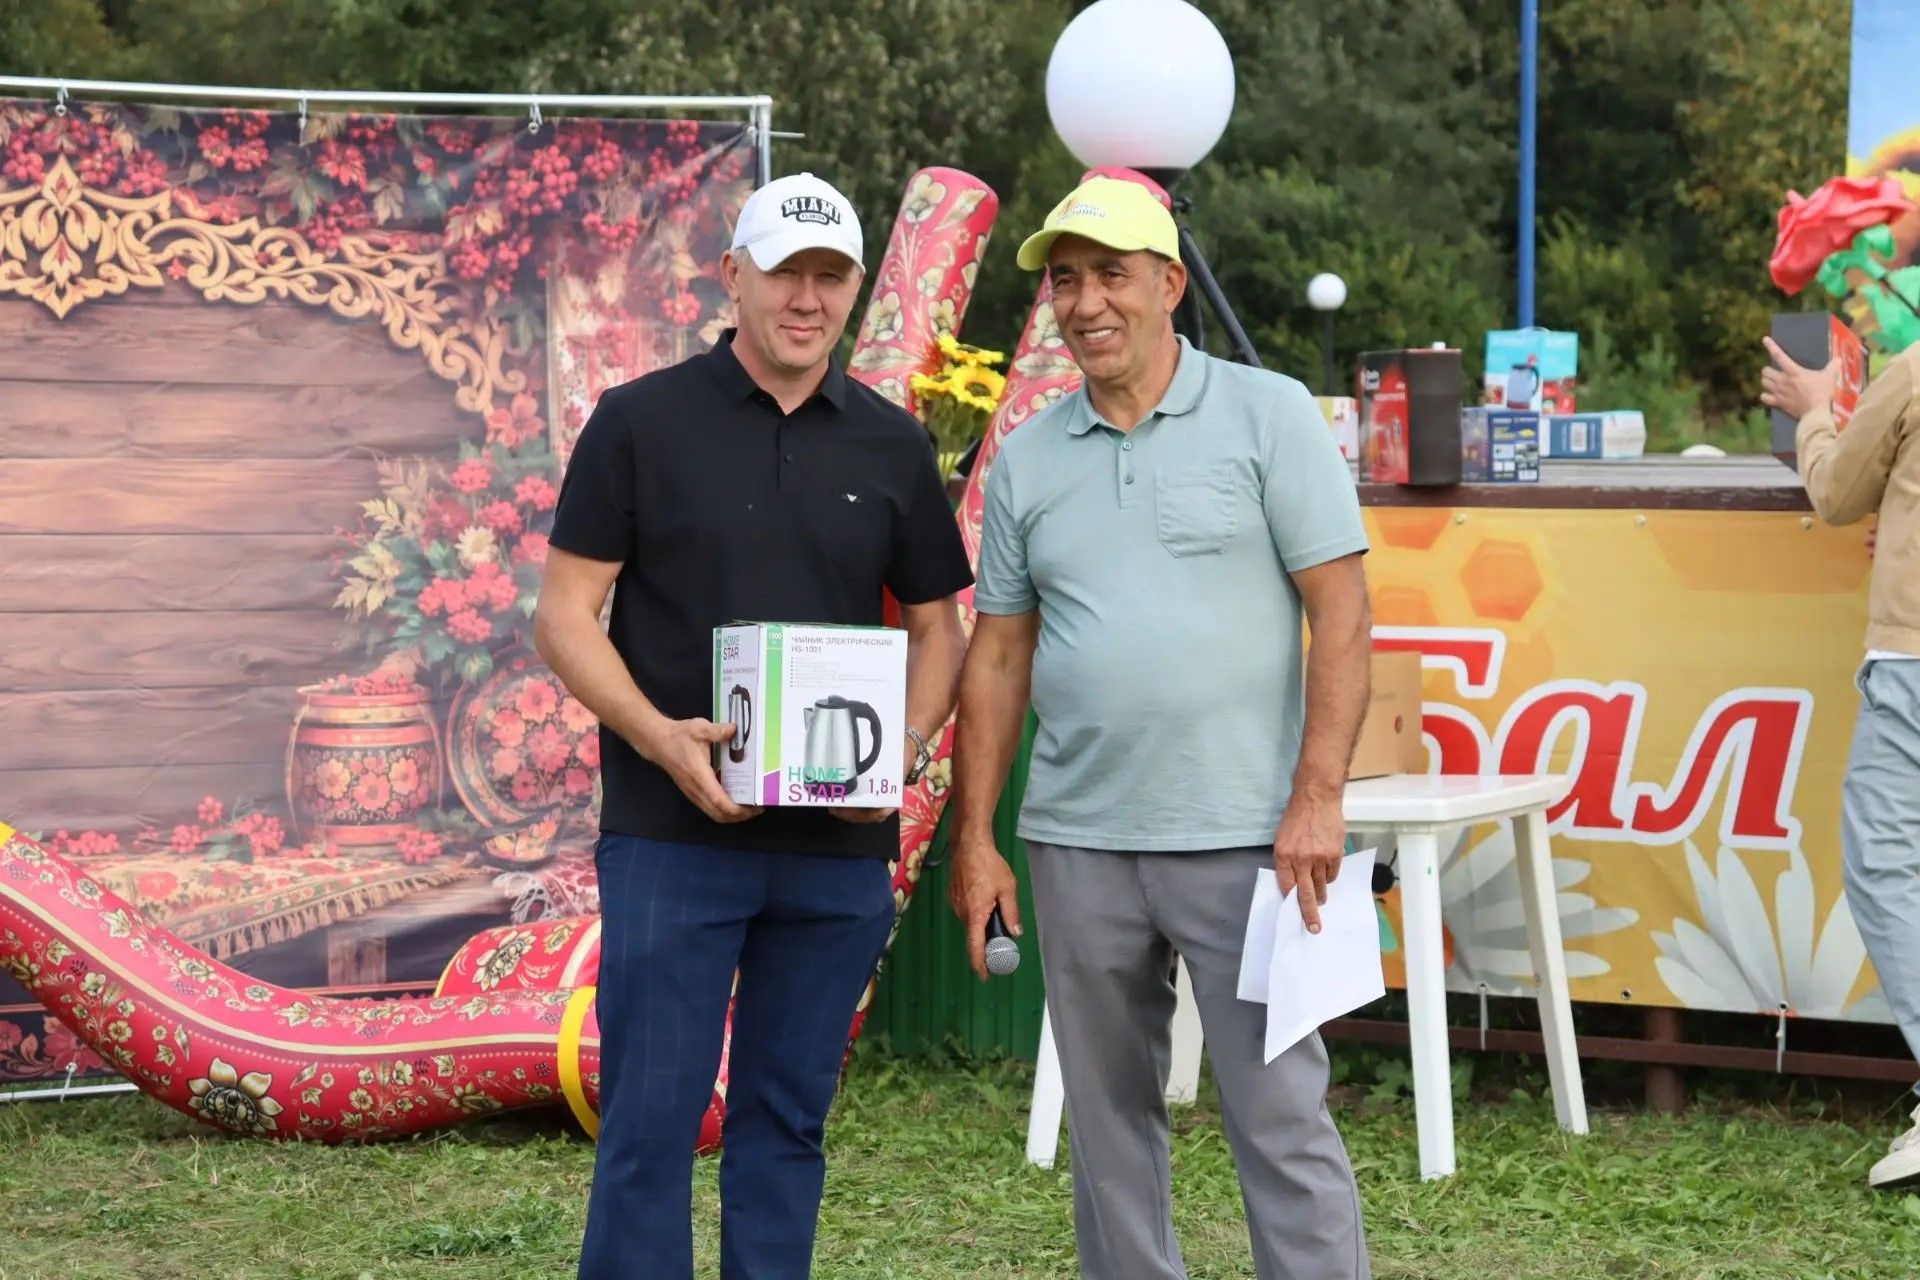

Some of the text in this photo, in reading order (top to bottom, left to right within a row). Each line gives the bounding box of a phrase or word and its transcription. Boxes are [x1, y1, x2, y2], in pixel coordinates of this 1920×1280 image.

[783, 197, 840, 223] MIAMI
[723, 634, 740, 646] HOME
[791, 635, 893, 646] ЧАЙНИК ЭЛЕКТРИЧЕСКИЙ
[723, 647, 740, 661] STAR
[788, 766, 846, 783] HOME
[788, 784, 846, 803] STAR
